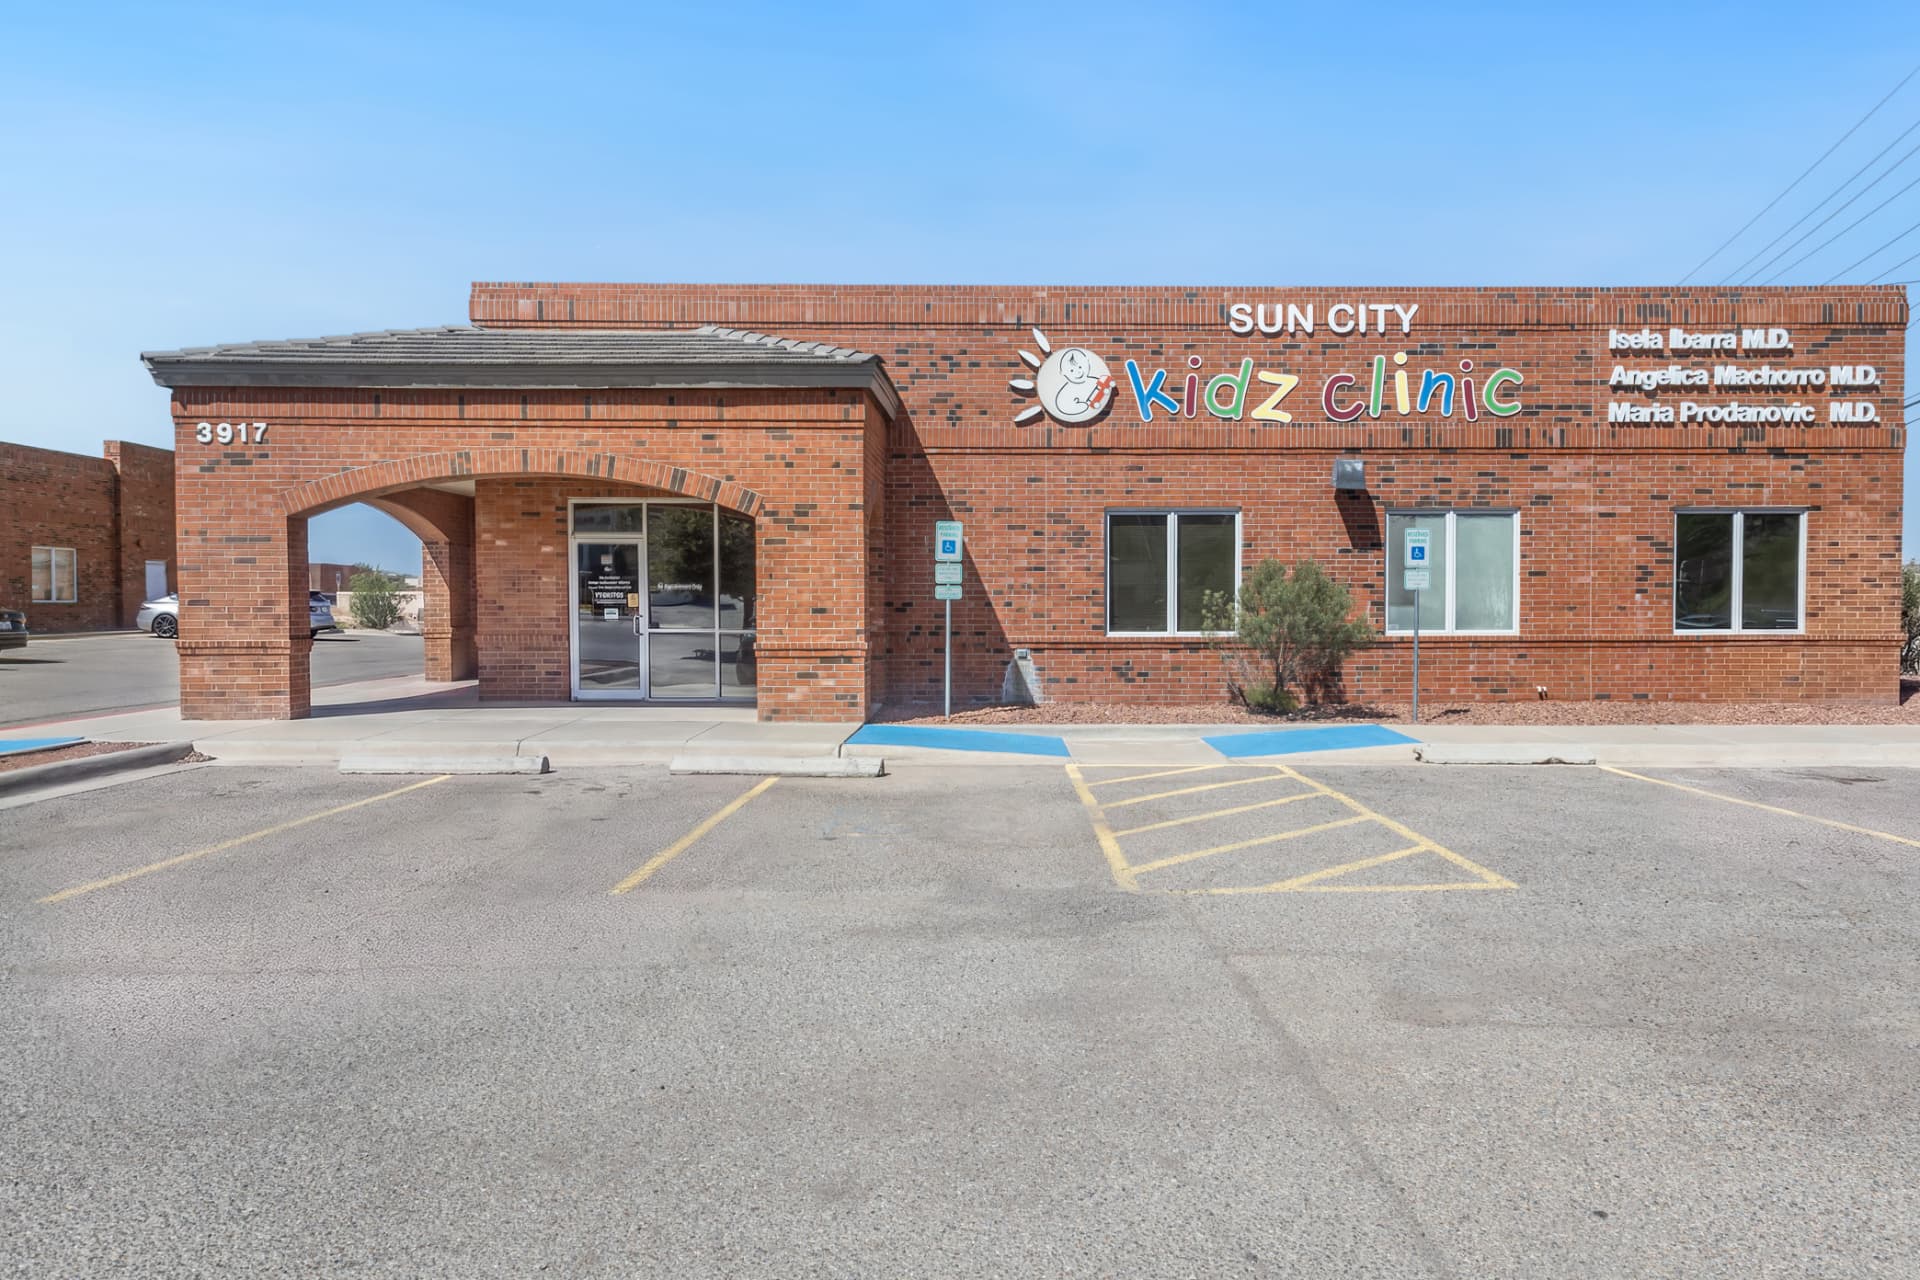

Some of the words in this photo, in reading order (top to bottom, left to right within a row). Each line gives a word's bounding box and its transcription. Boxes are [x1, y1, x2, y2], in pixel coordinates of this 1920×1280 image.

[1228, 303, 1314, 334] SUN
[1327, 303, 1419, 334] CITY
[1609, 329, 1663, 349] Isela
[1669, 329, 1737, 349] Ibarra
[1741, 329, 1793, 349] M.D.
[1322, 351, 1524, 421] clinic
[1609, 365, 1709, 390] Angelica
[1713, 365, 1826, 386] Machorro
[1829, 365, 1881, 385] M.D.
[1608, 402, 1675, 422] Maria
[1680, 402, 1816, 423] Prodanovic
[1829, 402, 1881, 422] M.D.
[196, 422, 267, 443] 3917
